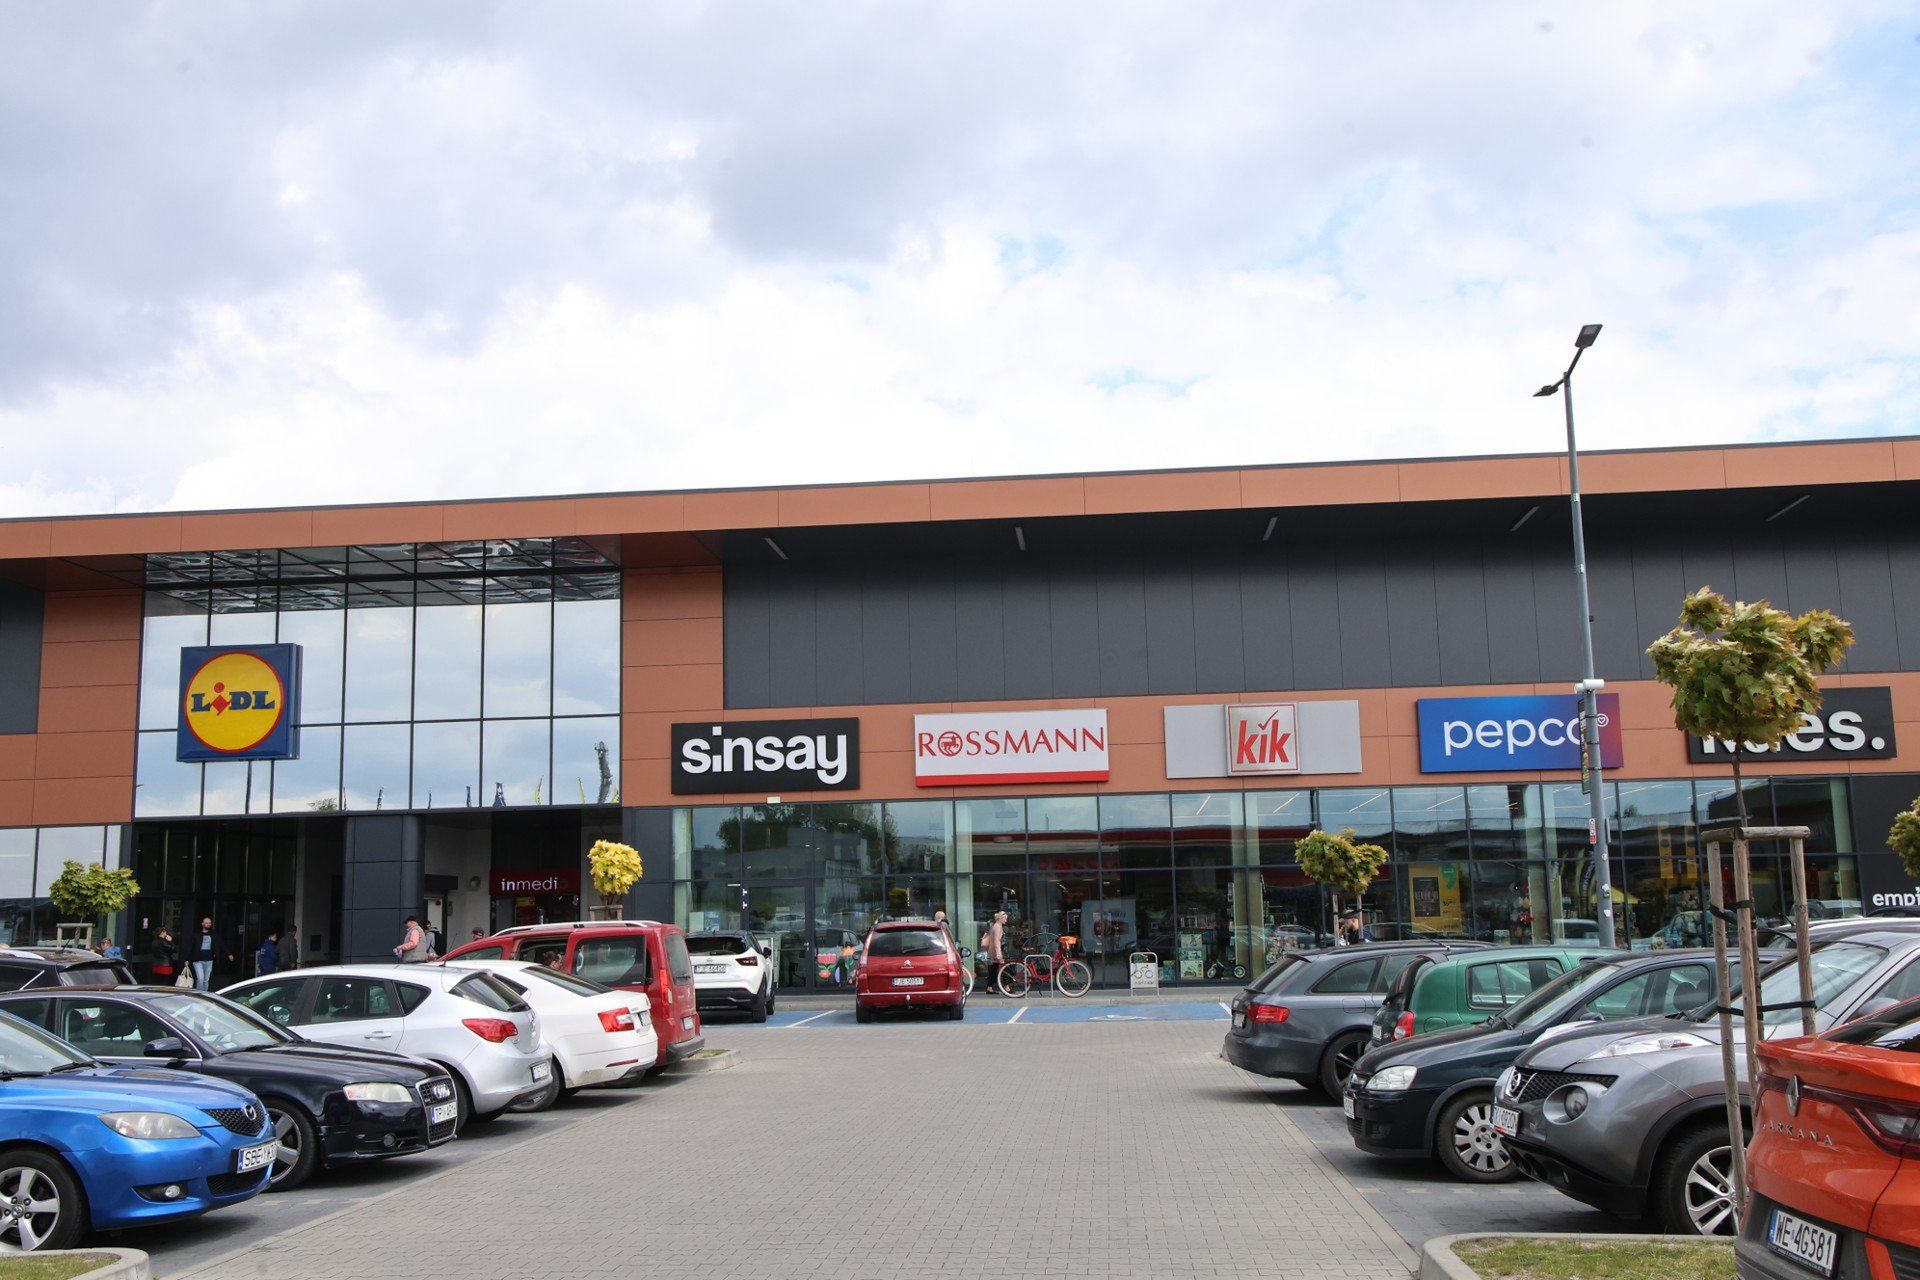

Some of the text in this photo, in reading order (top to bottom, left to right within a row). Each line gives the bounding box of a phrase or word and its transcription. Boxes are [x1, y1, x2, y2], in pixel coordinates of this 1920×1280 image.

[681, 726, 848, 785] sinsay
[917, 726, 1105, 758] ROSSMANN
[1236, 710, 1292, 765] kik
[1768, 1119, 1834, 1147] ARKANA
[1775, 1214, 1793, 1247] WE
[1793, 1223, 1833, 1266] 4G581
